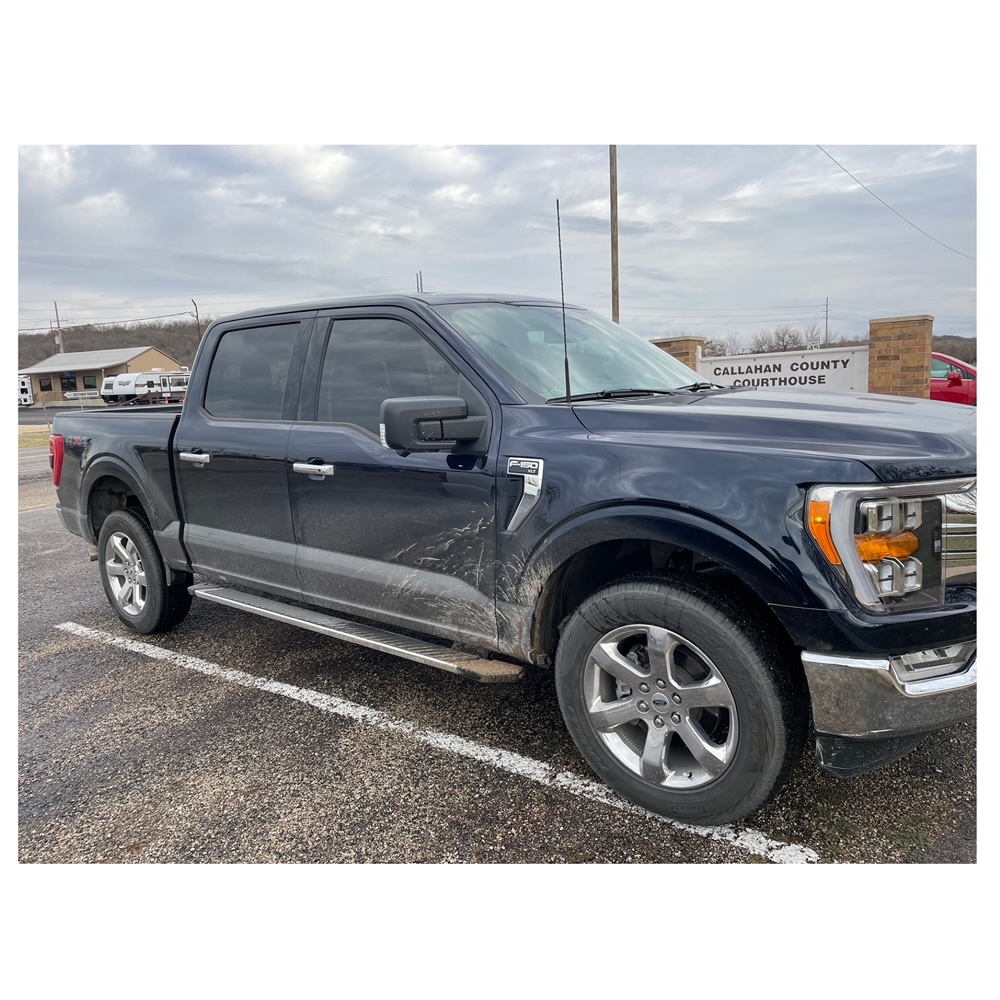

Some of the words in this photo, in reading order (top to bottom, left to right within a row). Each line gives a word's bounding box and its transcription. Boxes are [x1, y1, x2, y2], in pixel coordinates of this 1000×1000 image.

[713, 363, 782, 376] CALLAHAN
[790, 358, 850, 372] COUNTY
[733, 375, 826, 387] COURTHOUSE
